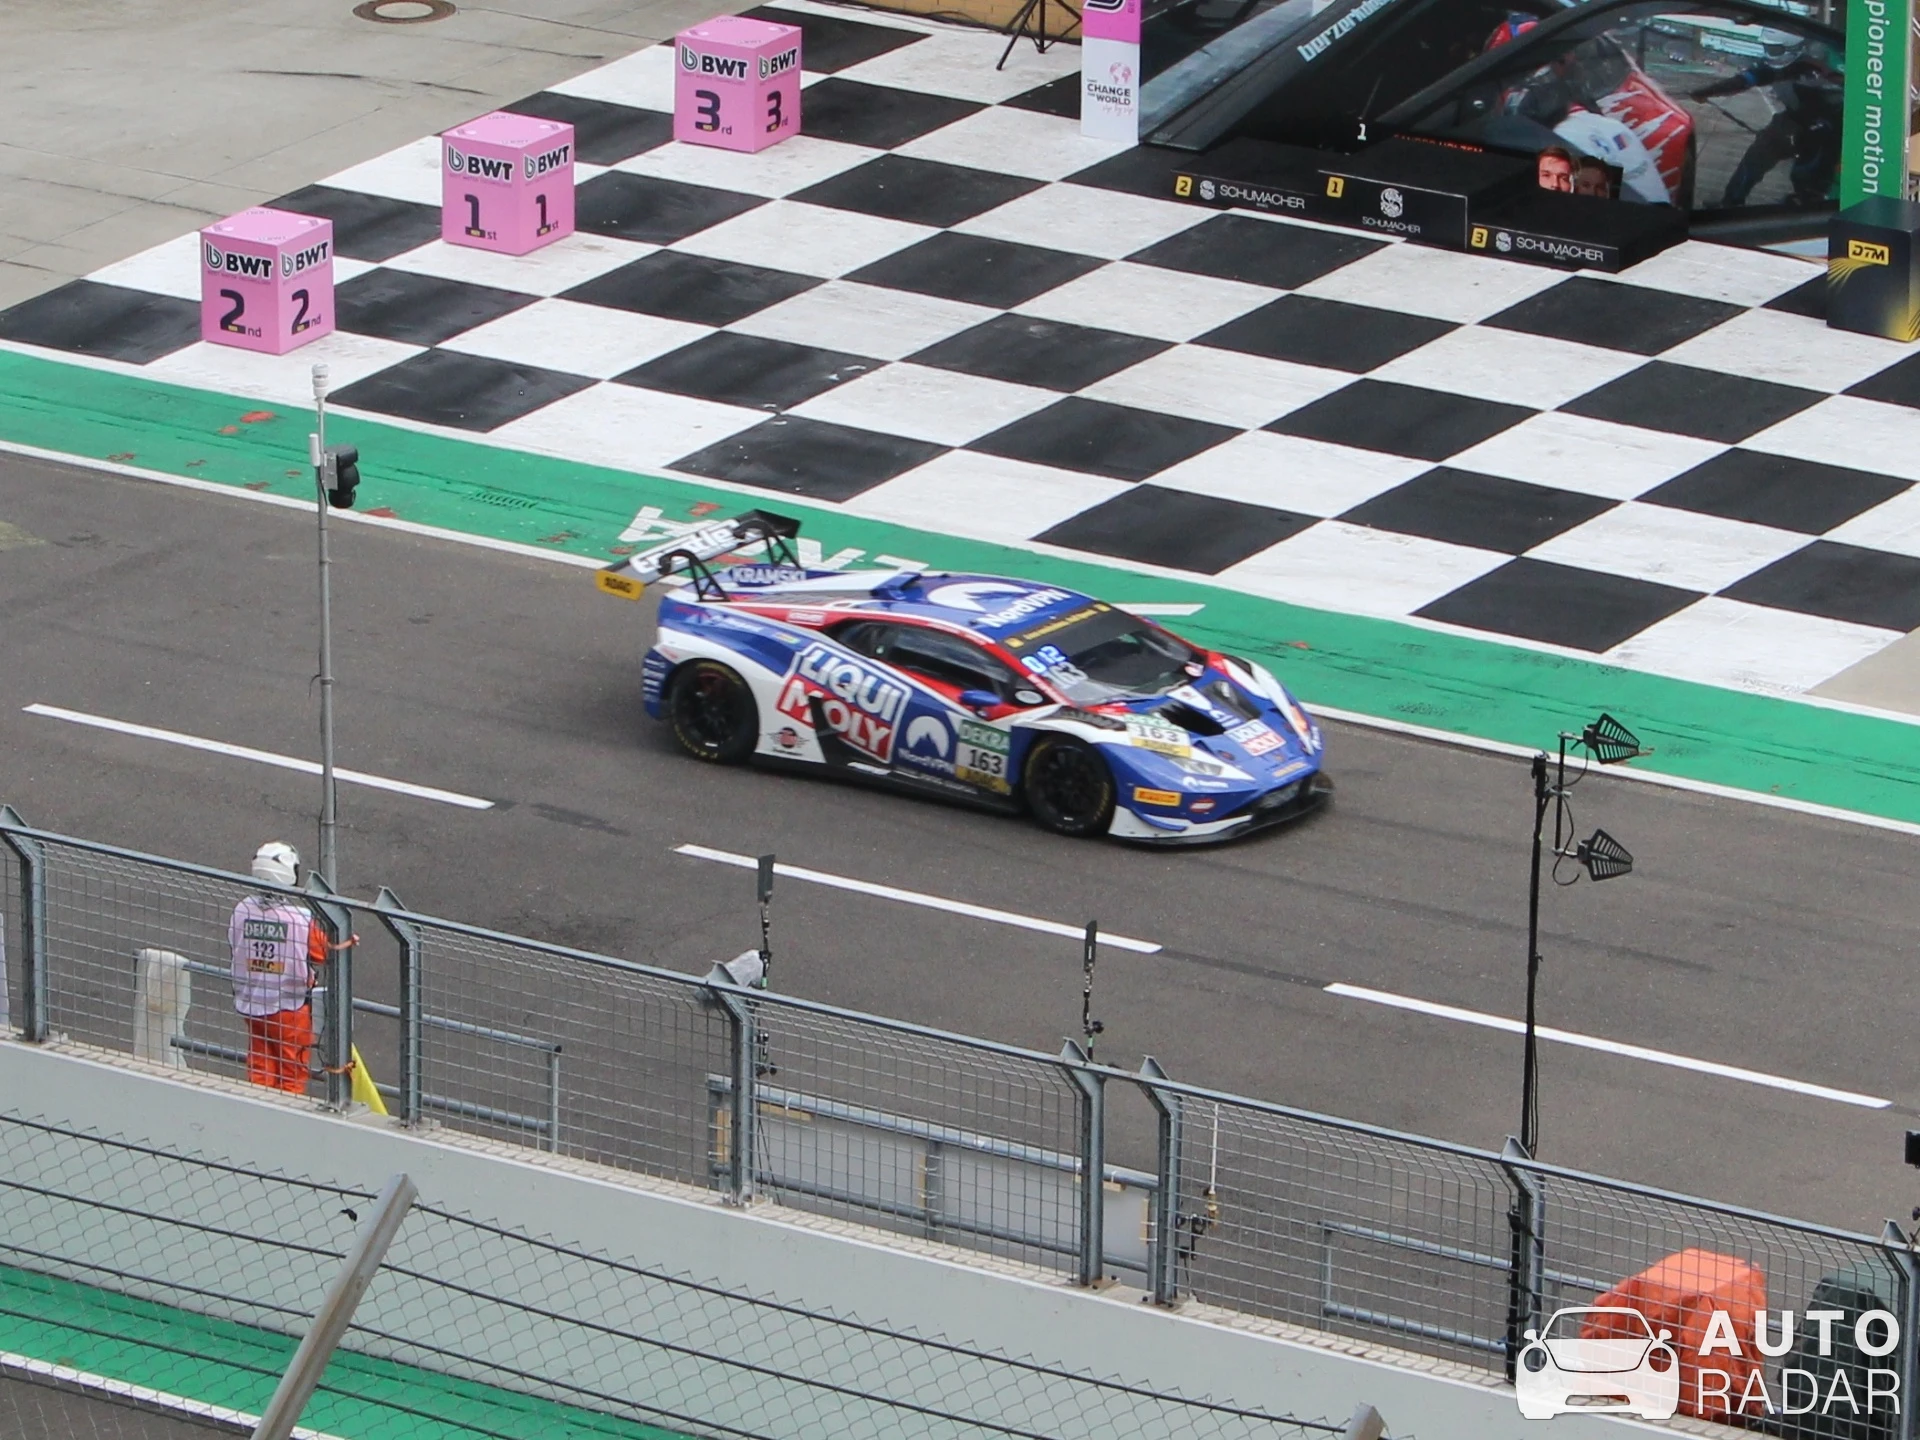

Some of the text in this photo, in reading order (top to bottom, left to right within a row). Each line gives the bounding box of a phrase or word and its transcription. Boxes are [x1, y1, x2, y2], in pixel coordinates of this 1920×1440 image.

[701, 55, 747, 78] BWT
[771, 49, 797, 74] BWT
[1087, 83, 1131, 97] CHANGE
[1096, 94, 1131, 106] WORLD
[1862, 0, 1890, 194] pioneer motion
[1357, 123, 1367, 140] 1
[468, 156, 512, 180] BWT
[538, 145, 569, 174] BWT
[1179, 181, 1305, 209] 2 SCHUMACHER
[1330, 182, 1339, 193] 1
[1362, 216, 1421, 234] SCHUMACHER
[296, 242, 328, 271] BWT
[1475, 232, 1604, 262] 3 SCHUMACHER
[1852, 245, 1885, 260] DTM
[226, 253, 272, 277] BWT
[977, 588, 1072, 628] NordVPN
[799, 649, 902, 722] LIQUI
[780, 679, 891, 754] MOLY
[960, 724, 1010, 750] DEKRA
[1137, 725, 1178, 742] 163
[969, 748, 1003, 775] 163
[245, 922, 286, 939] DEKRA
[252, 942, 275, 959] 123
